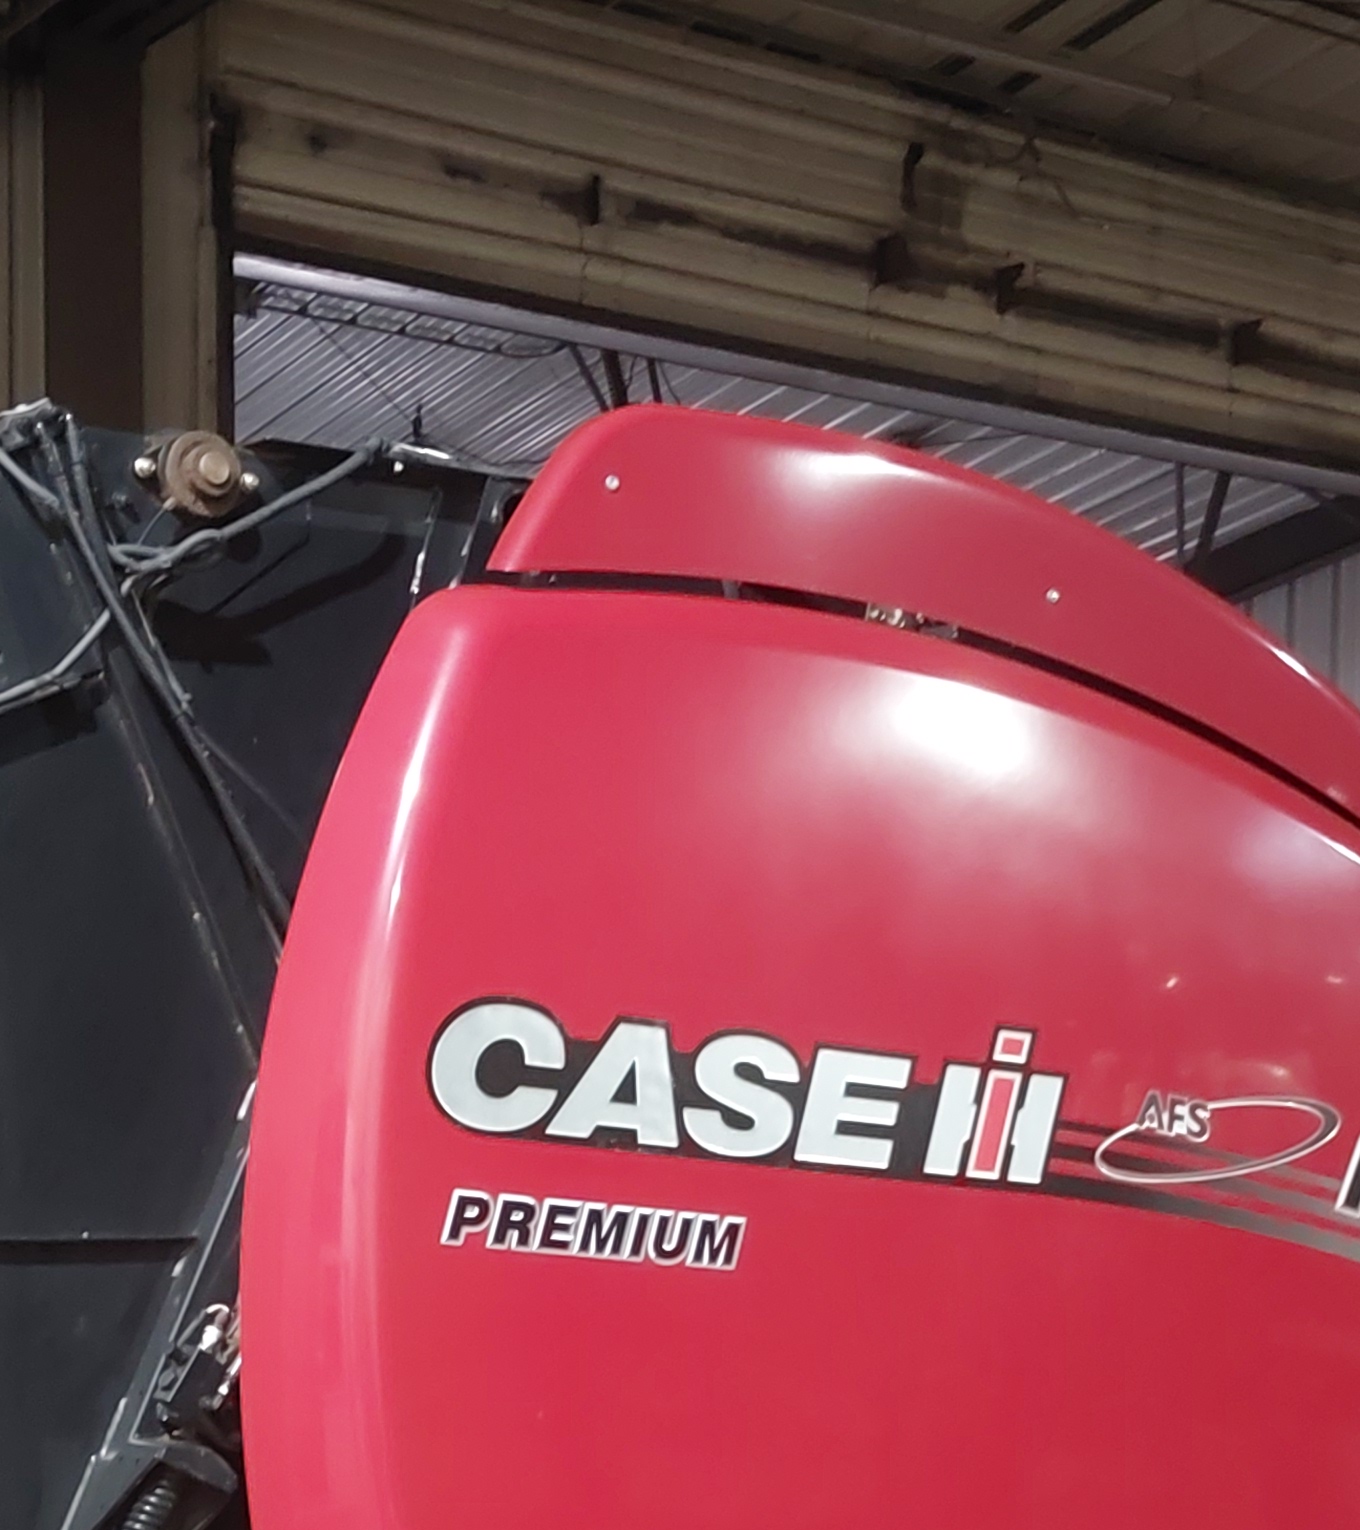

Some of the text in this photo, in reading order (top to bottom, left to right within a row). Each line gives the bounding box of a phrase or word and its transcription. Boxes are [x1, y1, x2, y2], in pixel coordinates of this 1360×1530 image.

[430, 1002, 913, 1170] CASE
[1137, 1089, 1212, 1142] AFS
[441, 1187, 747, 1270] PREMIUM
